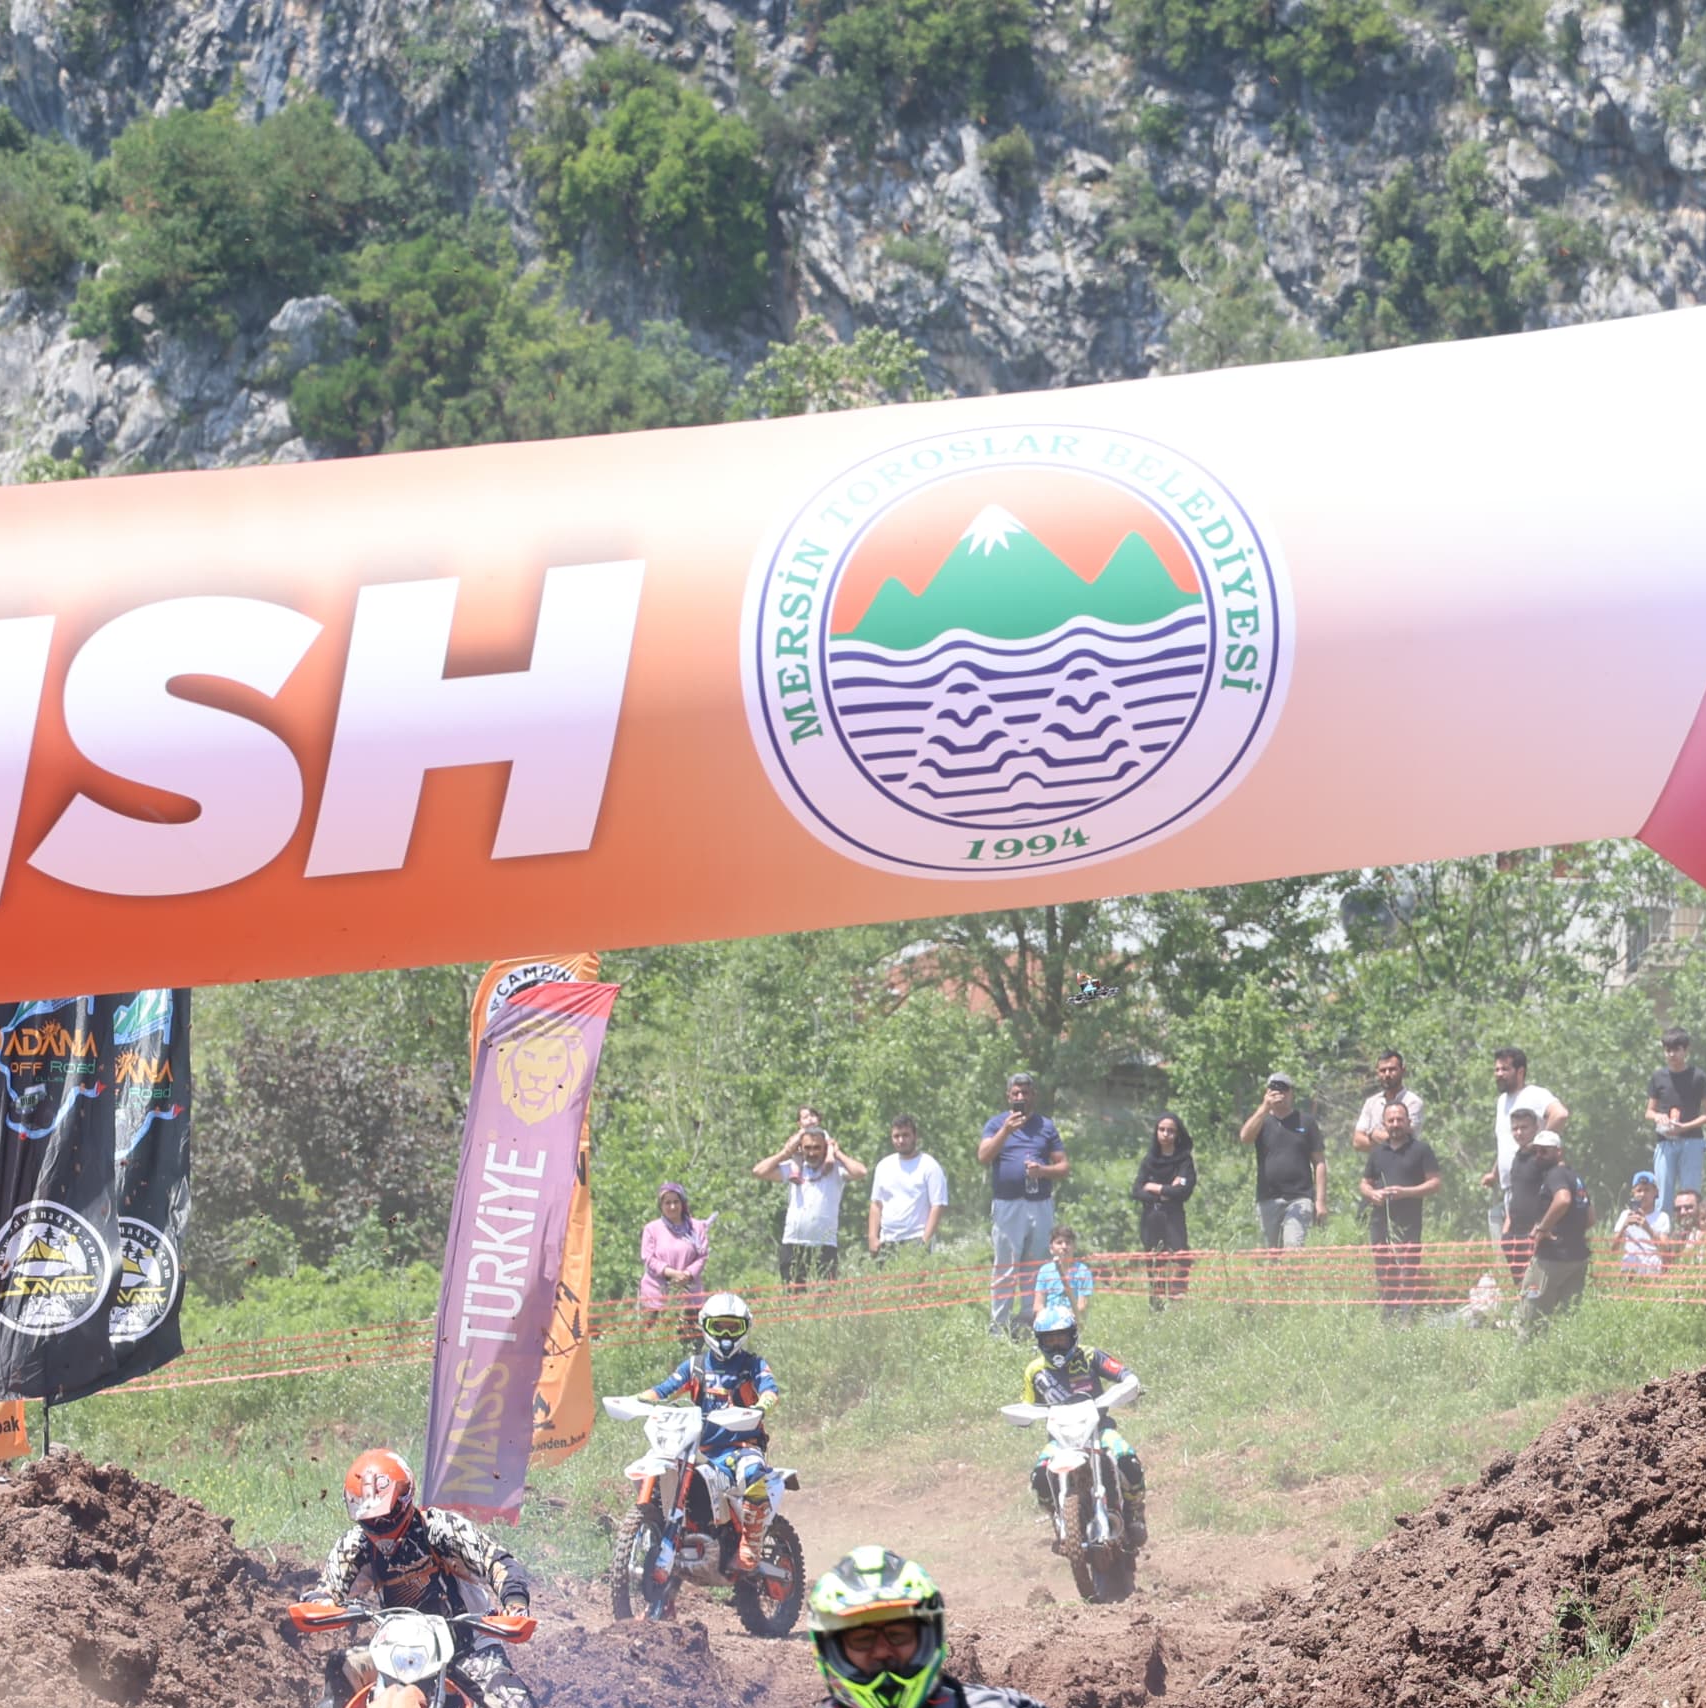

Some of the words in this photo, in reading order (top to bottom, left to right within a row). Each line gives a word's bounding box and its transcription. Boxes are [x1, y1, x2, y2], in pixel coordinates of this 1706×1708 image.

[775, 538, 831, 746] MERSİN
[819, 433, 1084, 529] TOROSLAR
[1100, 438, 1265, 696] BELEDİYESİ
[960, 826, 1092, 863] 1994
[4, 1027, 98, 1058] ADANA
[11, 1061, 43, 1077] OFF
[458, 1141, 548, 1349] TÜRKİYE
[444, 1359, 511, 1496] MASS
